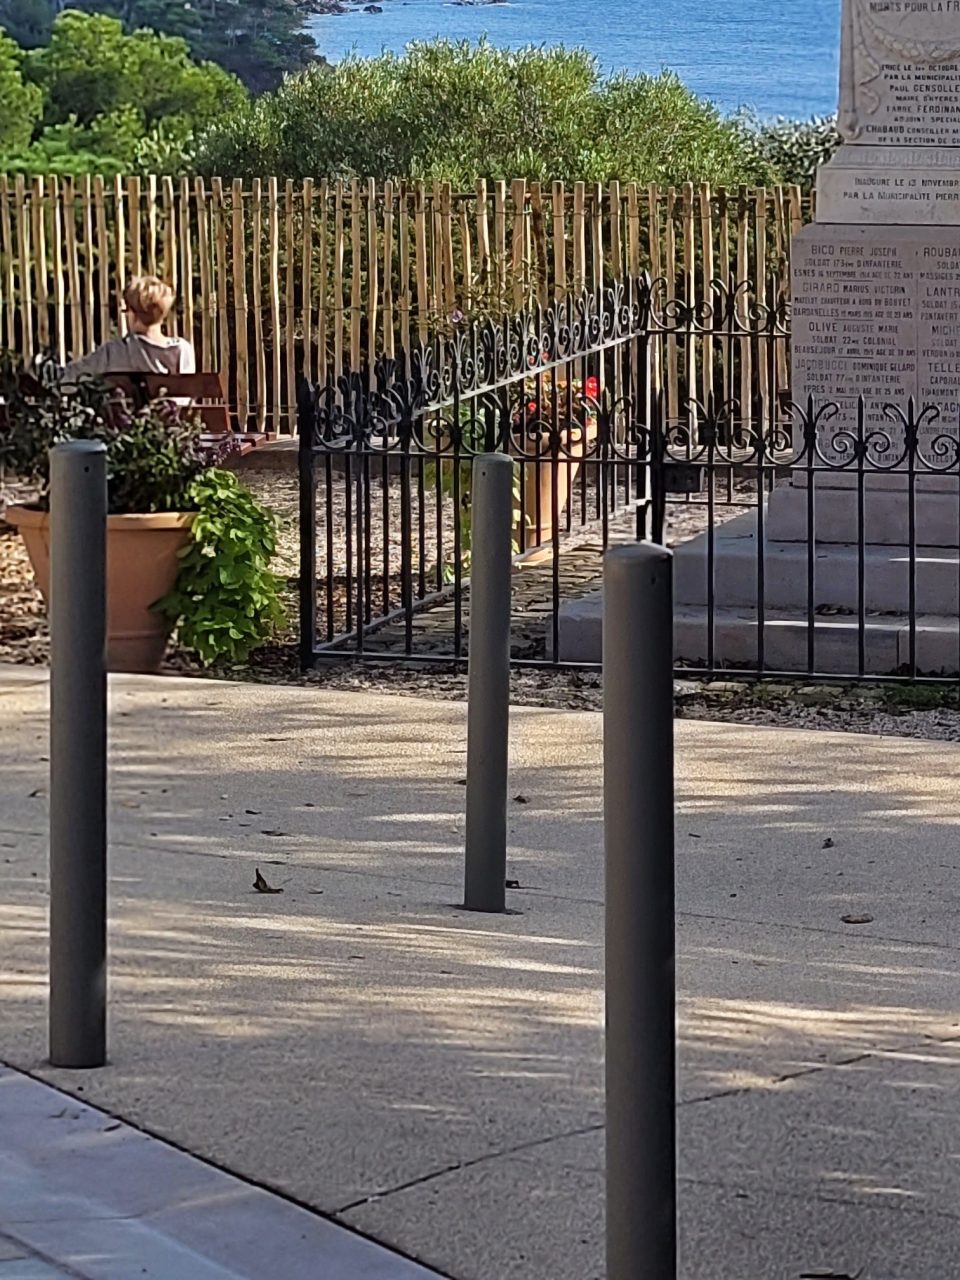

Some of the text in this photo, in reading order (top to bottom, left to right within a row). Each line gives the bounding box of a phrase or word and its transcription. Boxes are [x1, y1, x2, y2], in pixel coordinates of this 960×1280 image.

[905, 2, 927, 11] POUR
[931, 2, 942, 12] LA
[895, 178, 903, 186] LE
[840, 247, 864, 256] PIERRE
[804, 258, 830, 266] SOLDAT
[803, 283, 839, 292] GIRARD
[843, 285, 869, 293] MARIUS
[922, 300, 947, 308] SOLDAT
[809, 322, 838, 332] OLIVE
[878, 325, 898, 334] MARIE
[807, 373, 832, 381] SOLDAT
